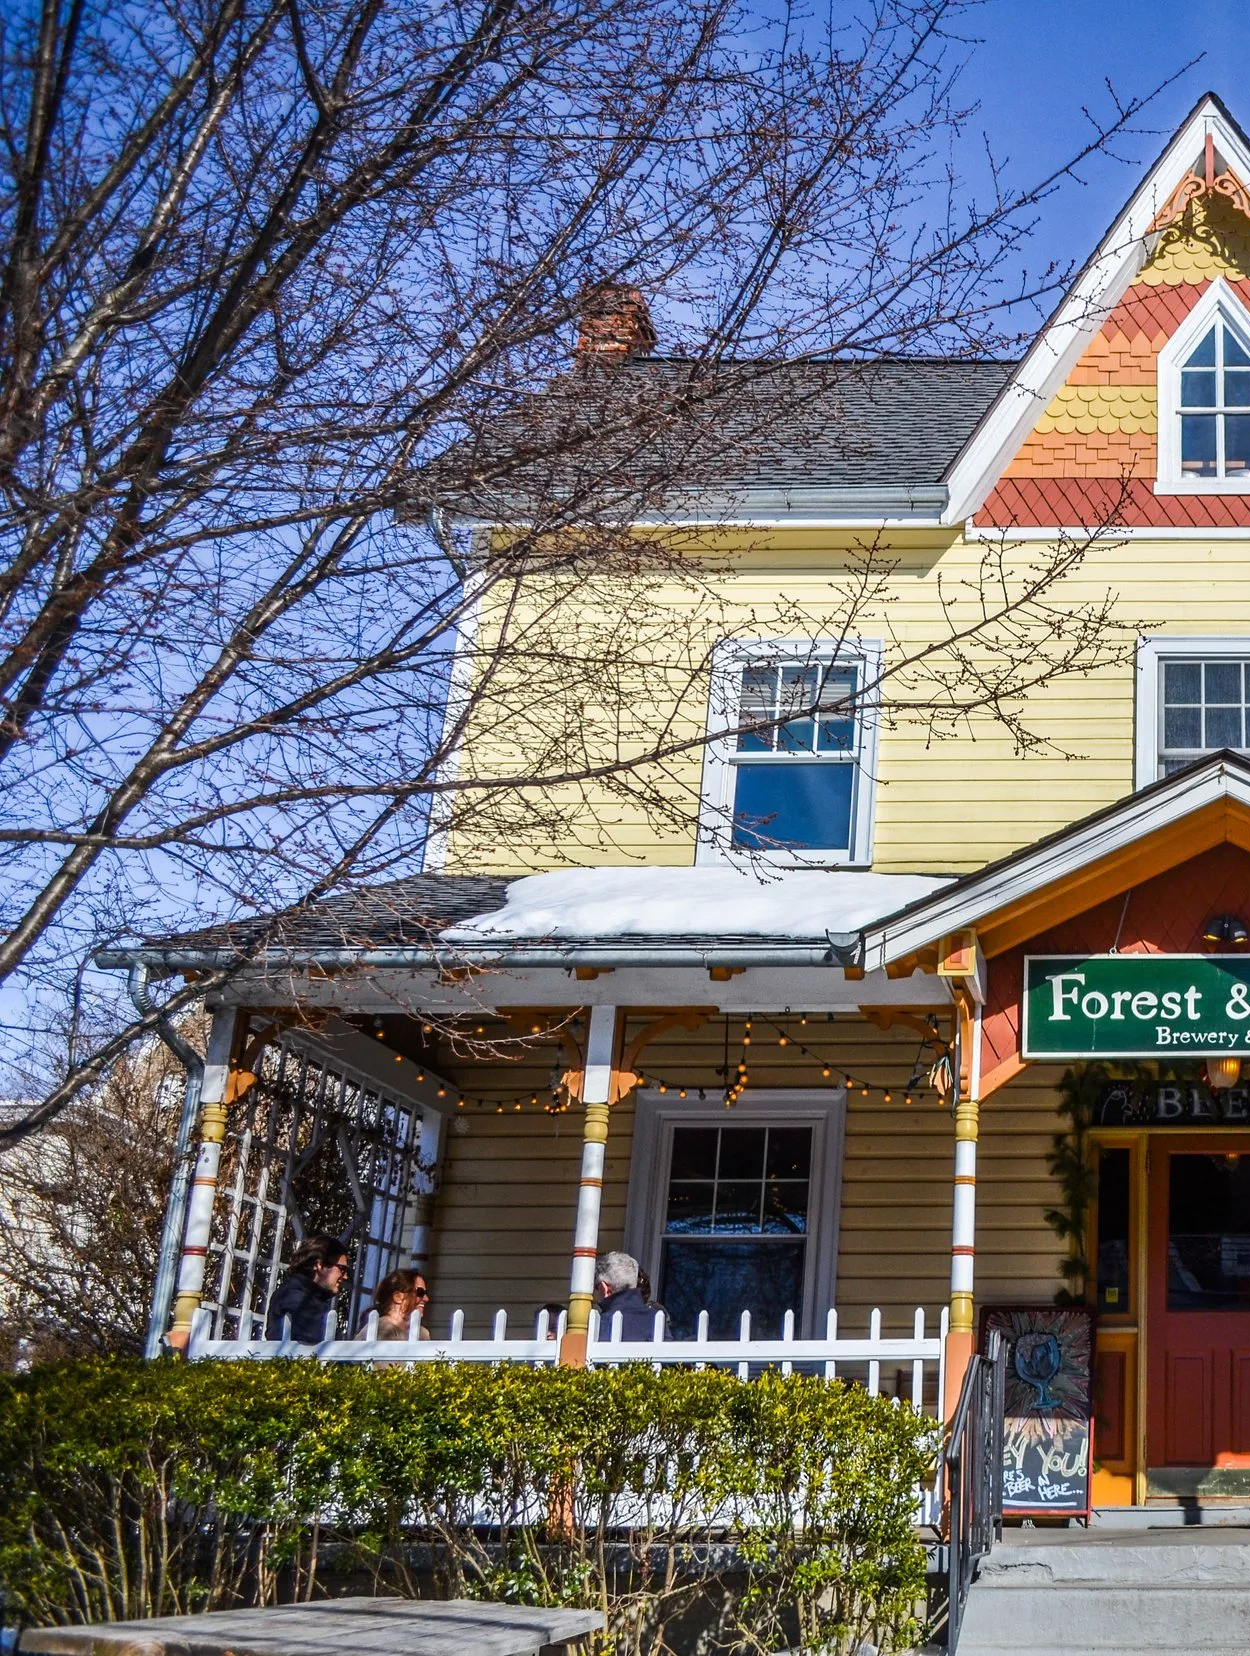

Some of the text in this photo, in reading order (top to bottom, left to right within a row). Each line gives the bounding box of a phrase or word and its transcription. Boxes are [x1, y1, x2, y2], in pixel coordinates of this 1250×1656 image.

[1045, 972, 1203, 1021] Forest
[1155, 1025, 1239, 1046] Brewery
[1003, 1432, 1089, 1477] EY YOU!
[1004, 1477, 1036, 1498] BEER
